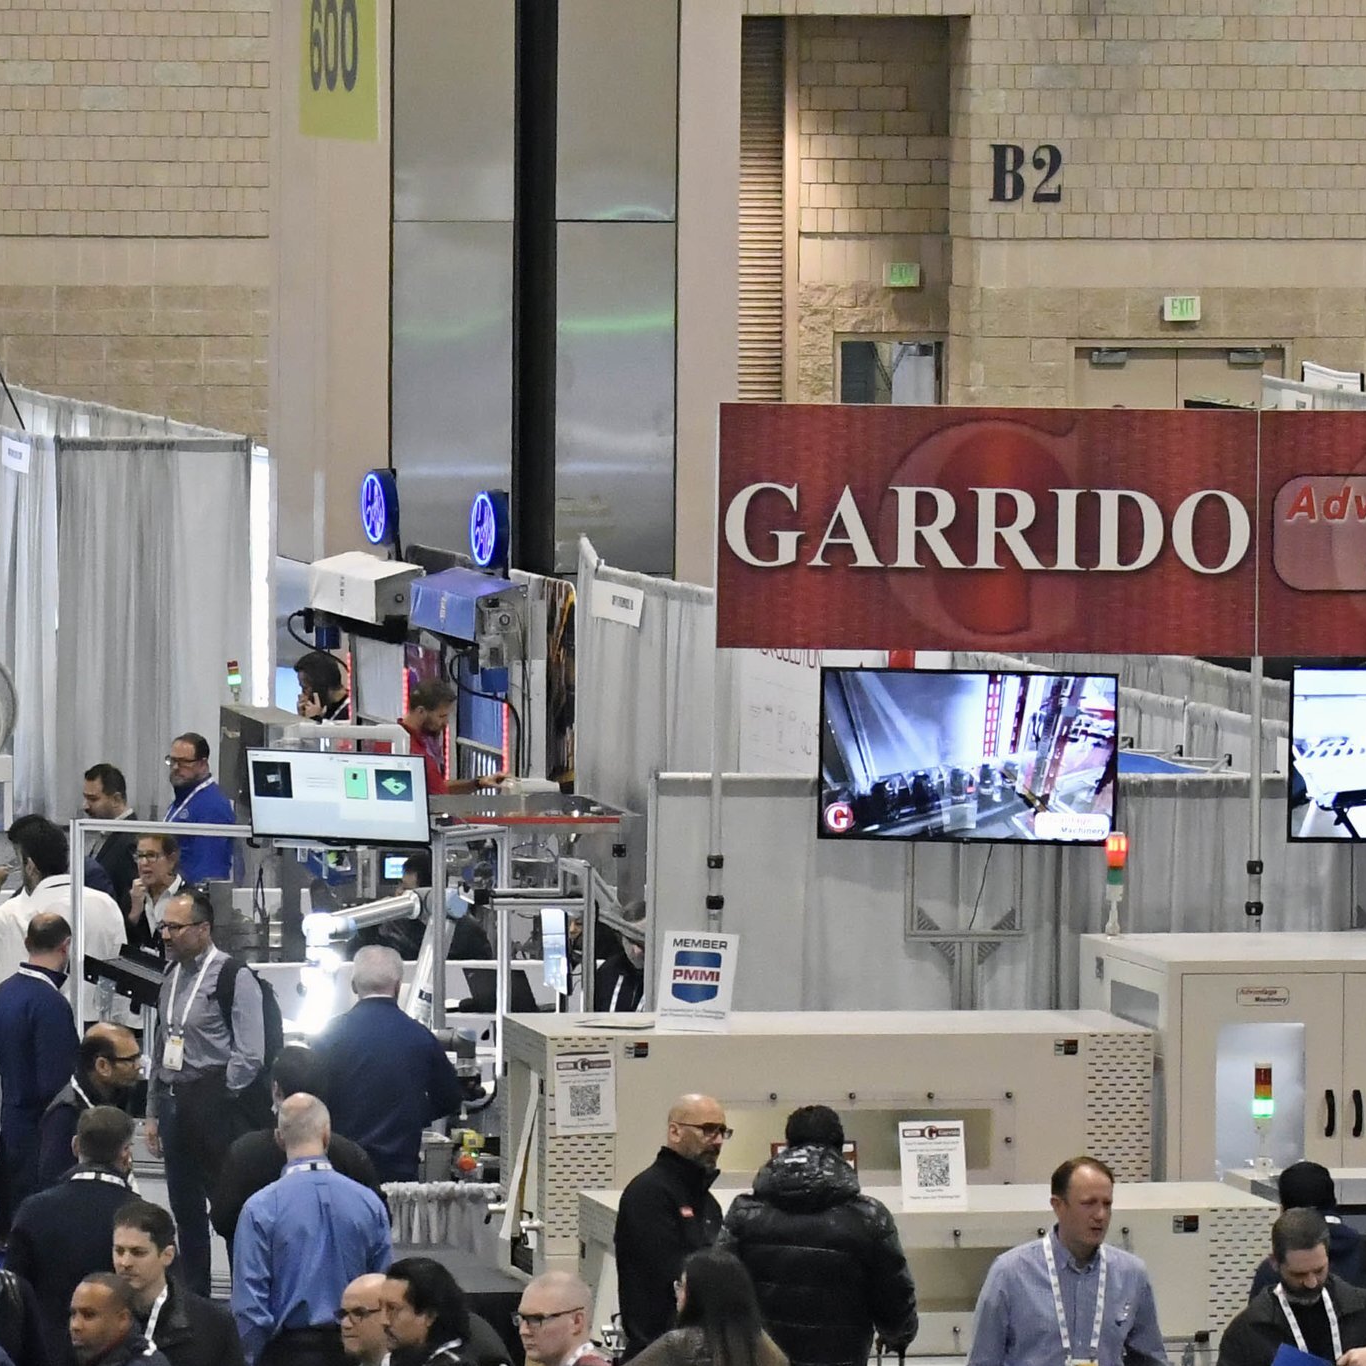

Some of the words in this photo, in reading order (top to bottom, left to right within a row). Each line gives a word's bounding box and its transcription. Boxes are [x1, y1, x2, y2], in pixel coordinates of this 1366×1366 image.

[310, 0, 358, 91] 600
[989, 143, 1063, 203] B2
[1170, 297, 1197, 318] EXIT
[724, 481, 1252, 575] GARRIDO
[672, 938, 728, 950] MEMBER
[672, 968, 721, 983] PMMI
